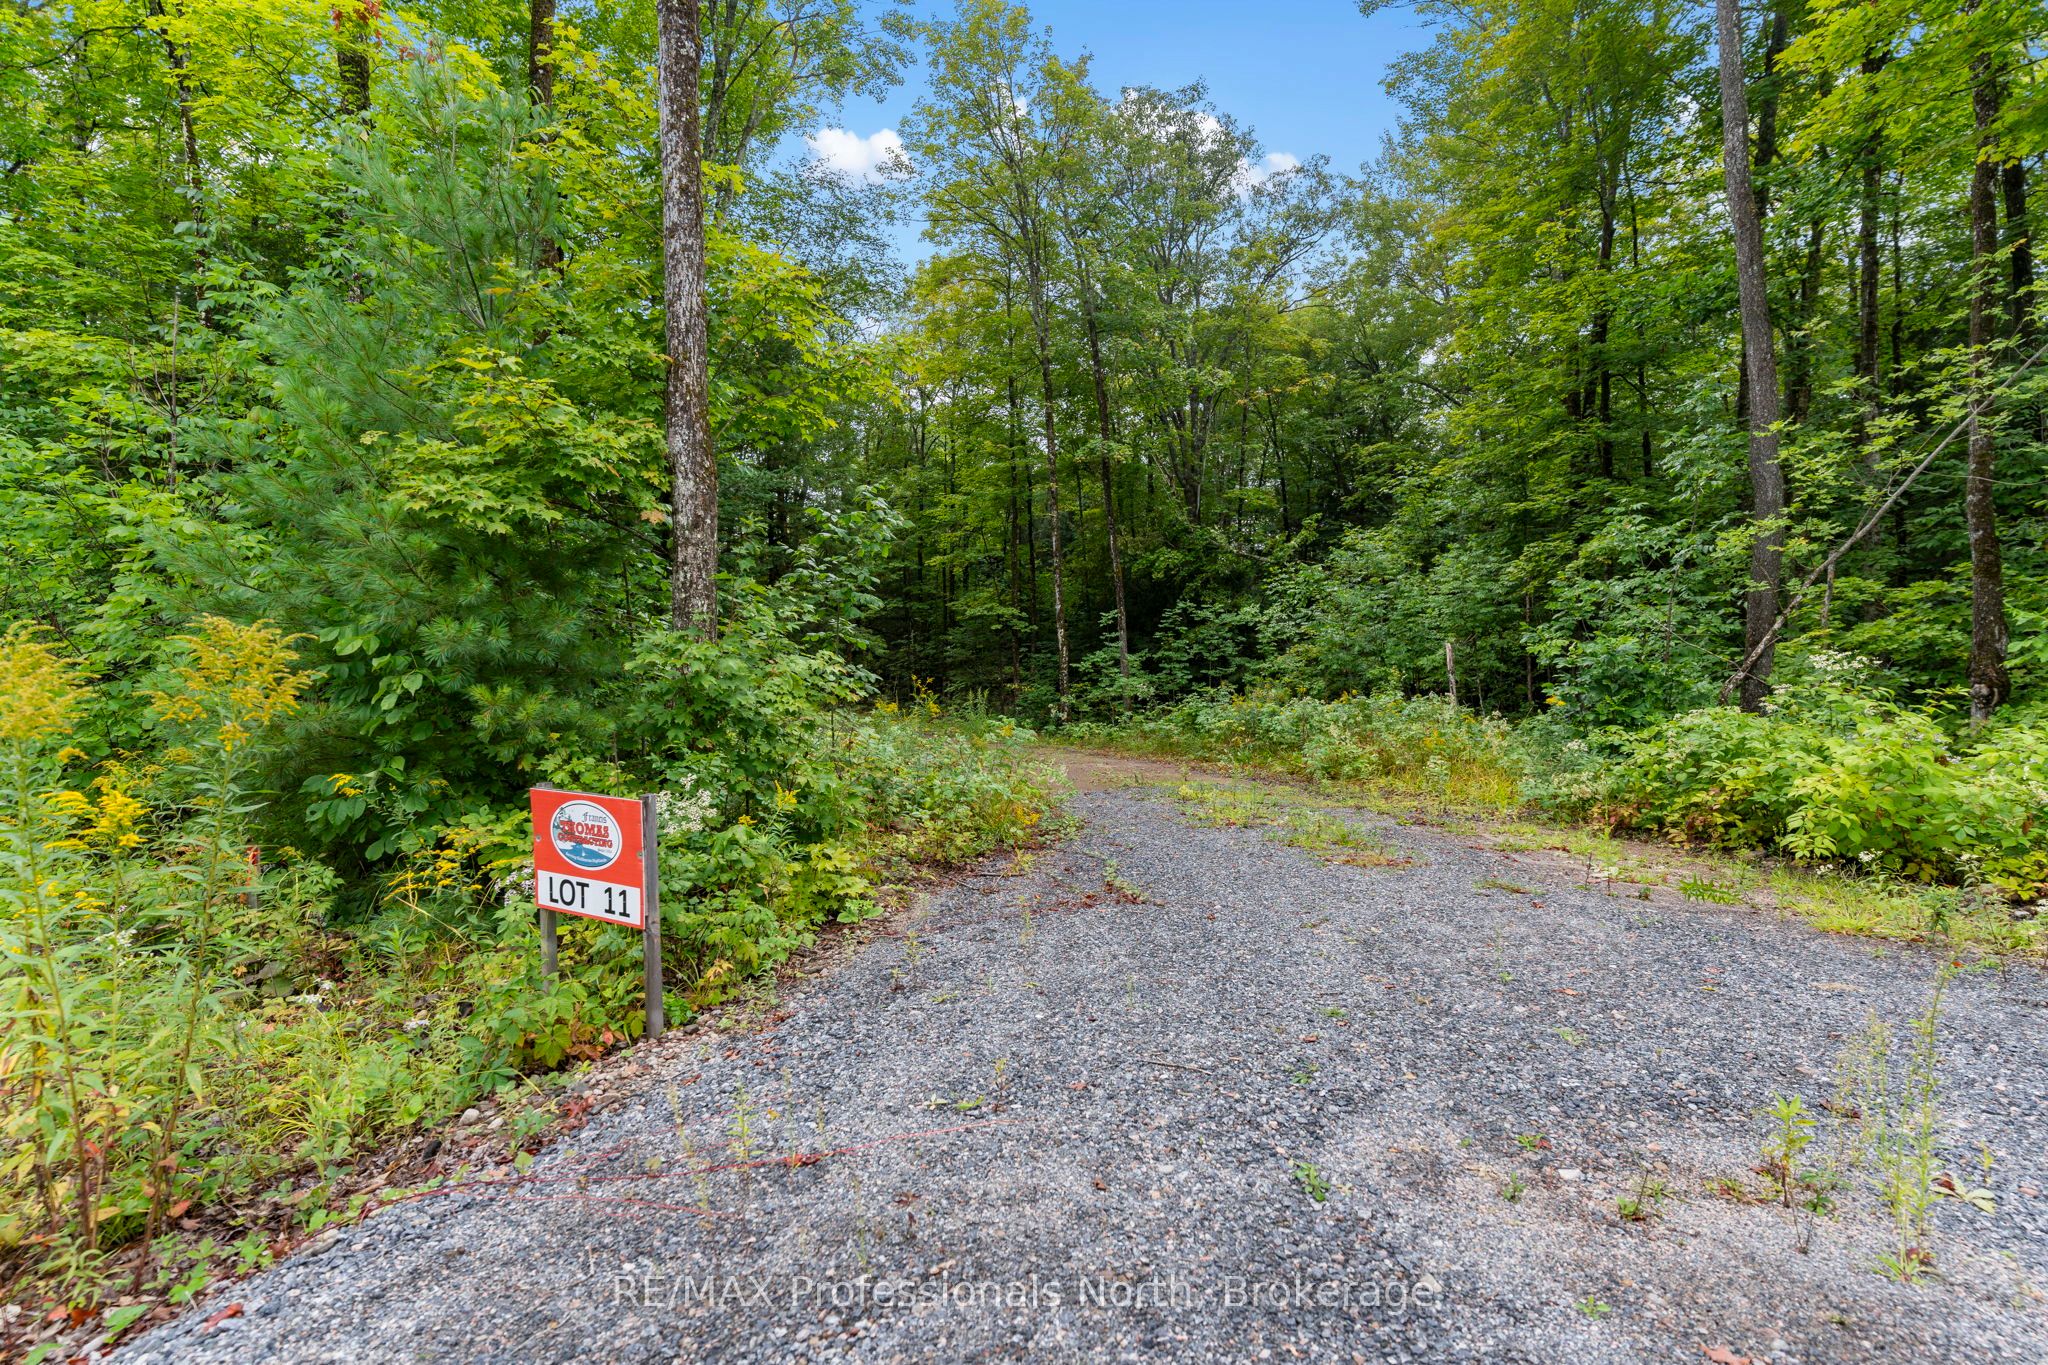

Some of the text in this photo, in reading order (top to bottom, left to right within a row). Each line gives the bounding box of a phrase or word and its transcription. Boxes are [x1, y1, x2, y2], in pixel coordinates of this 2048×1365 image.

[559, 820, 609, 839] THOMAS
[549, 876, 631, 918] LOT 11
